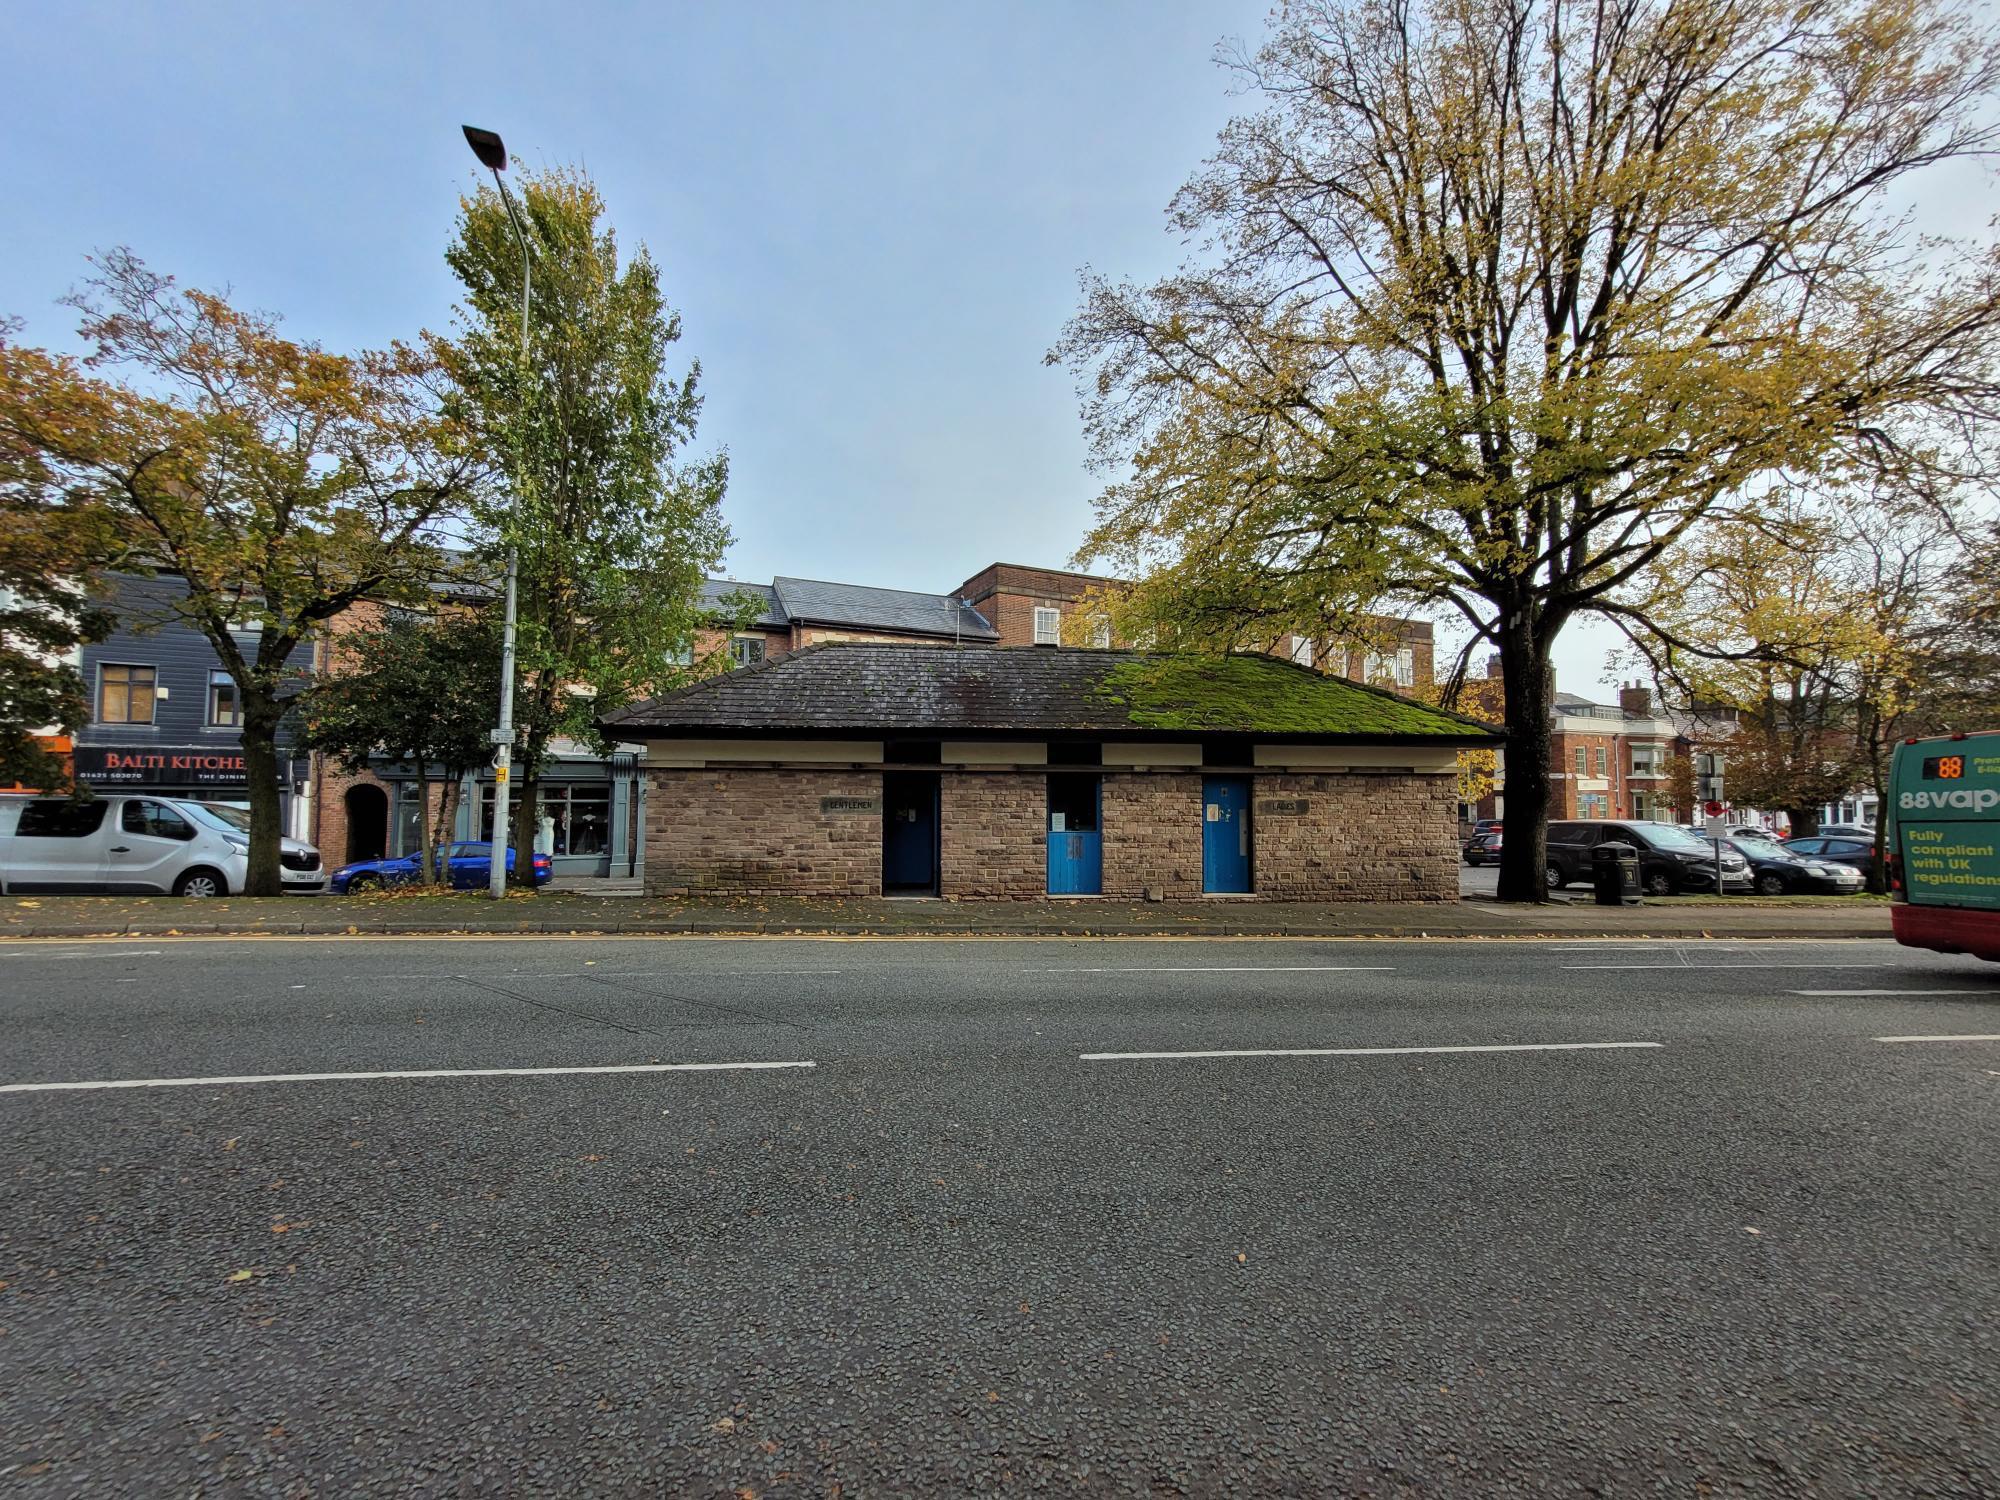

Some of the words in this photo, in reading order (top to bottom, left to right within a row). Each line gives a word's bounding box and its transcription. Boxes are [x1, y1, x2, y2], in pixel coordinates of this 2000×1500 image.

[171, 756, 248, 770] KITCHE
[1939, 756, 1962, 778] 88
[1899, 789, 2000, 813] 88vap
[1909, 831, 1943, 842] Fully
[1911, 845, 1994, 857] compliant
[1912, 858, 1945, 869] with
[1948, 859, 1971, 870] UK
